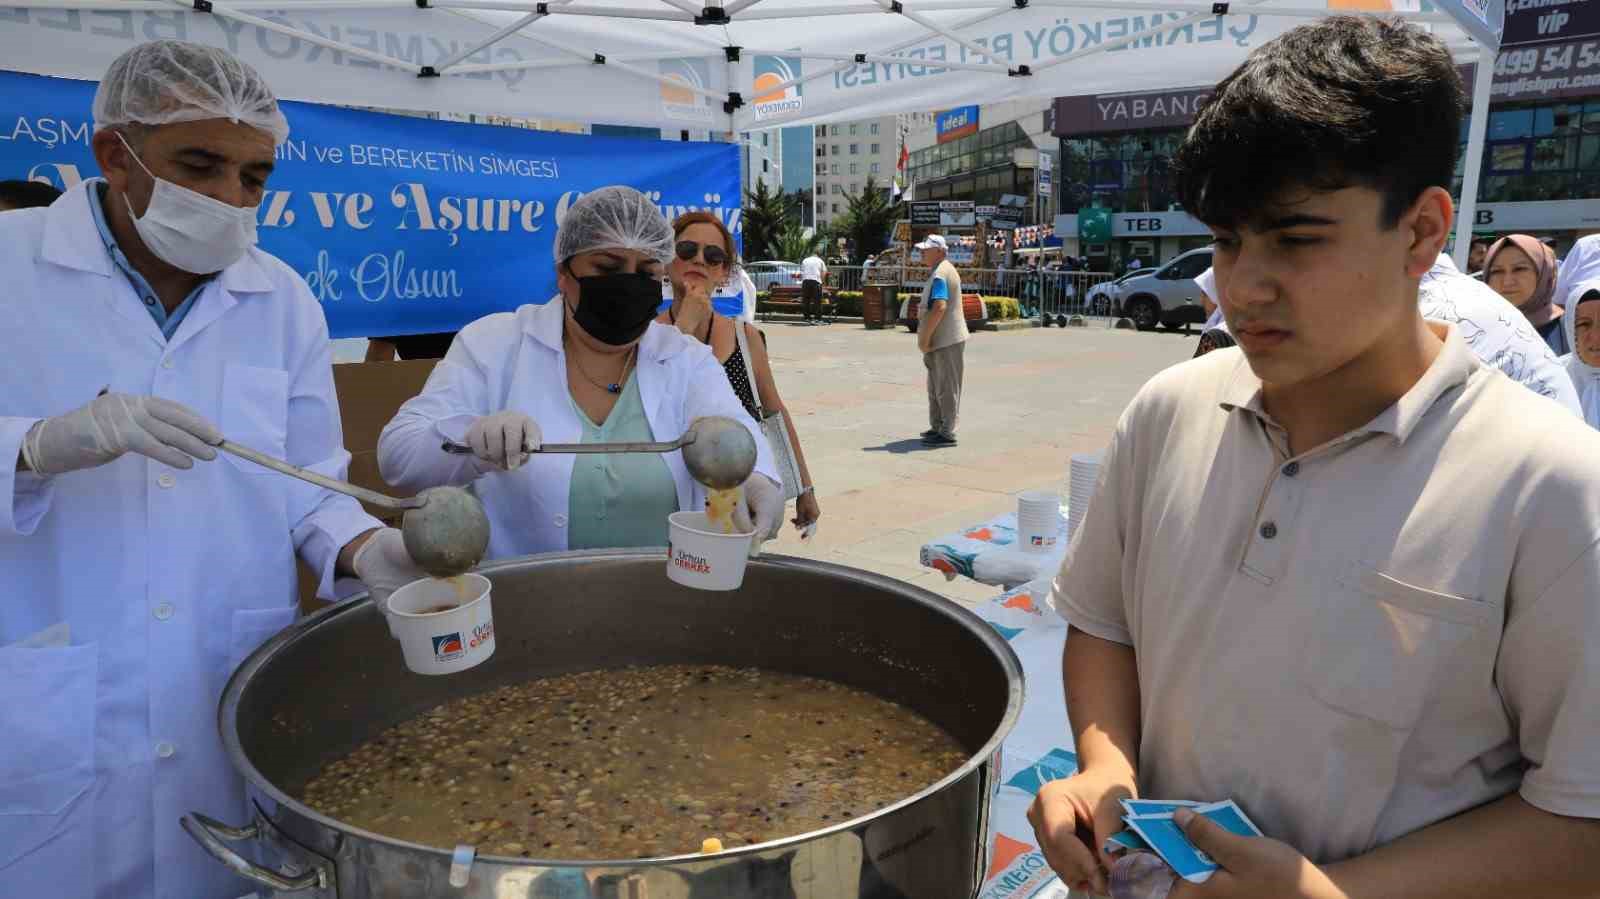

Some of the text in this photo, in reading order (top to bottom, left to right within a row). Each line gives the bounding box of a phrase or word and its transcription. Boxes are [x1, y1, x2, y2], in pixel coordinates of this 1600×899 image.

[1537, 9, 1569, 35] VİP
[1540, 44, 1575, 72] 54
[314, 147, 343, 164] ve
[351, 144, 475, 173] BEREKETİN
[479, 153, 560, 179] SİMGESİ
[309, 191, 374, 230] ve
[391, 183, 544, 247] Aşure
[1124, 218, 1162, 232] TEB
[351, 250, 463, 302] Olsun
